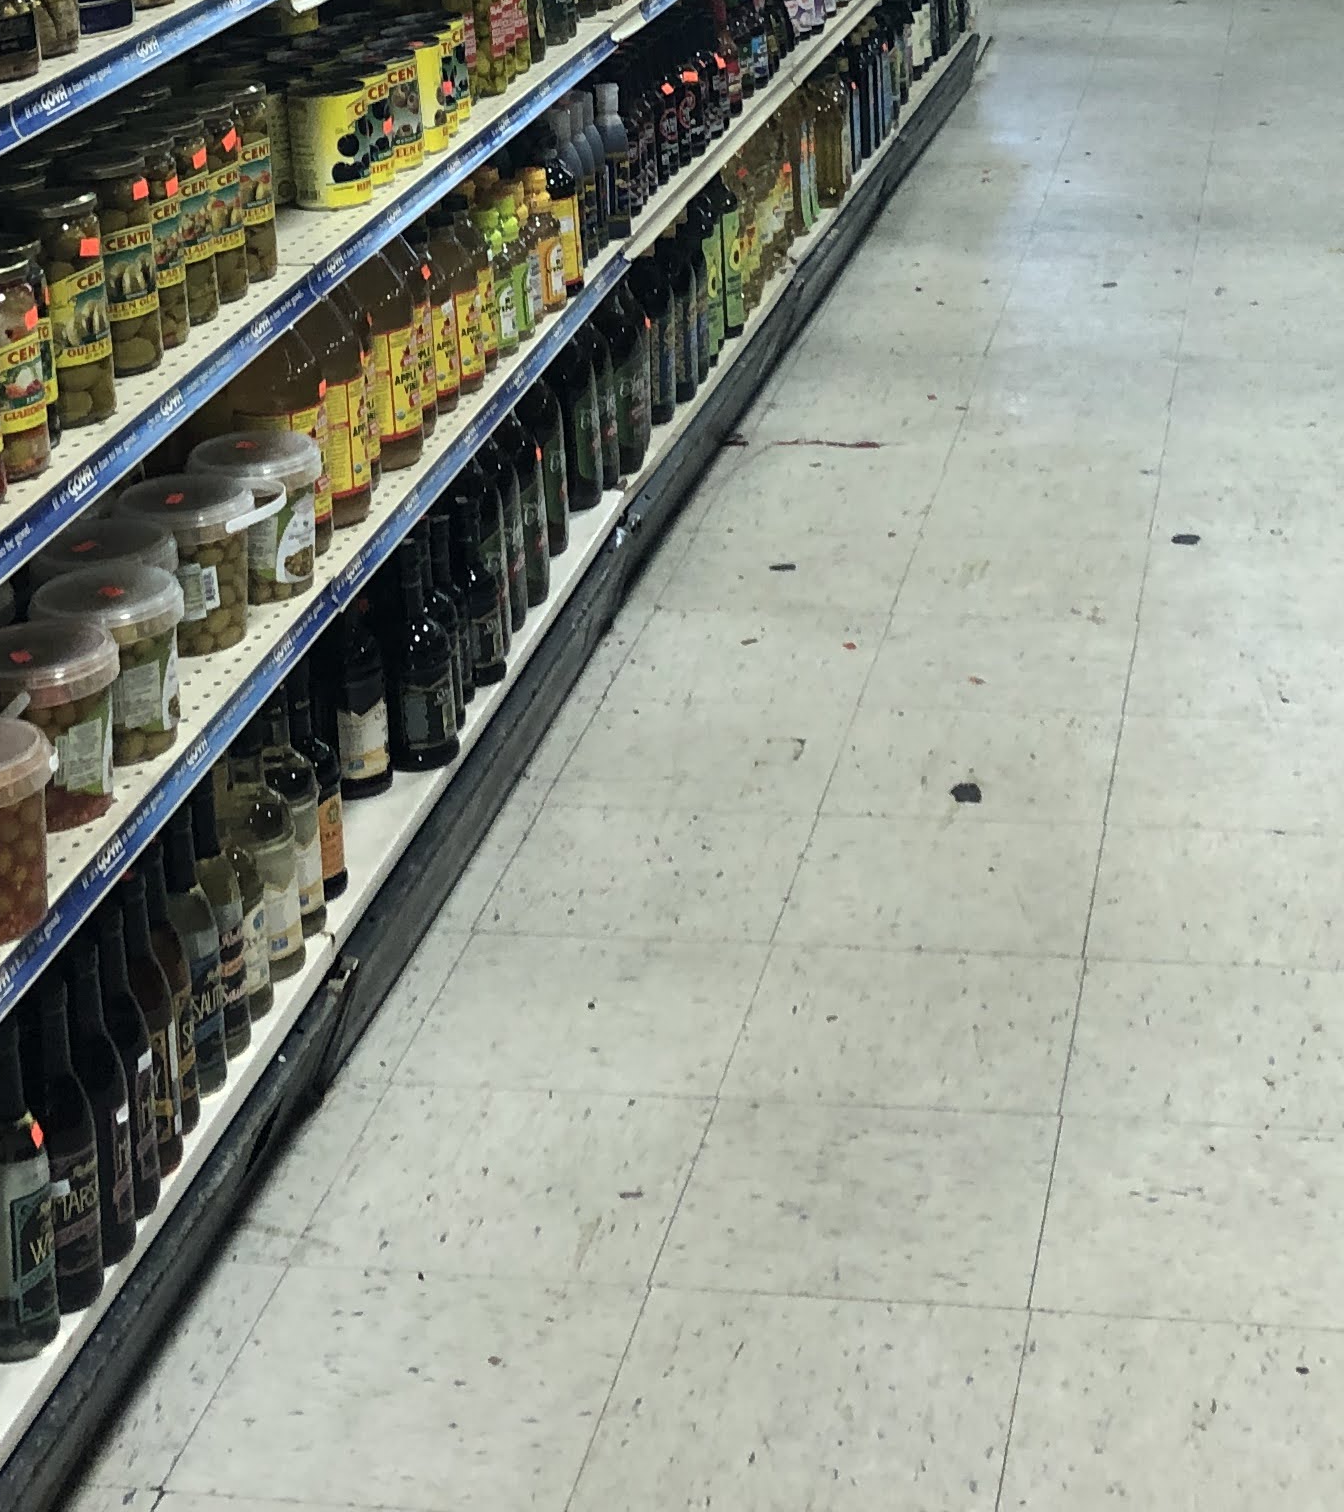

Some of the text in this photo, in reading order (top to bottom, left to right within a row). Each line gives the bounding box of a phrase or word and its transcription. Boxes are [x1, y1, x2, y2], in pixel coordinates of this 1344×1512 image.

[136, 35, 160, 58] GOYA
[41, 83, 68, 111] GOYA
[105, 230, 151, 251] CENTO
[327, 251, 344, 272] GOYA
[251, 314, 271, 338] GOYA
[160, 388, 183, 416] GOYA
[68, 464, 95, 496] GOYA
[273, 631, 294, 663] GOYA
[185, 733, 209, 766] GOYA
[96, 834, 124, 876] GOYA
